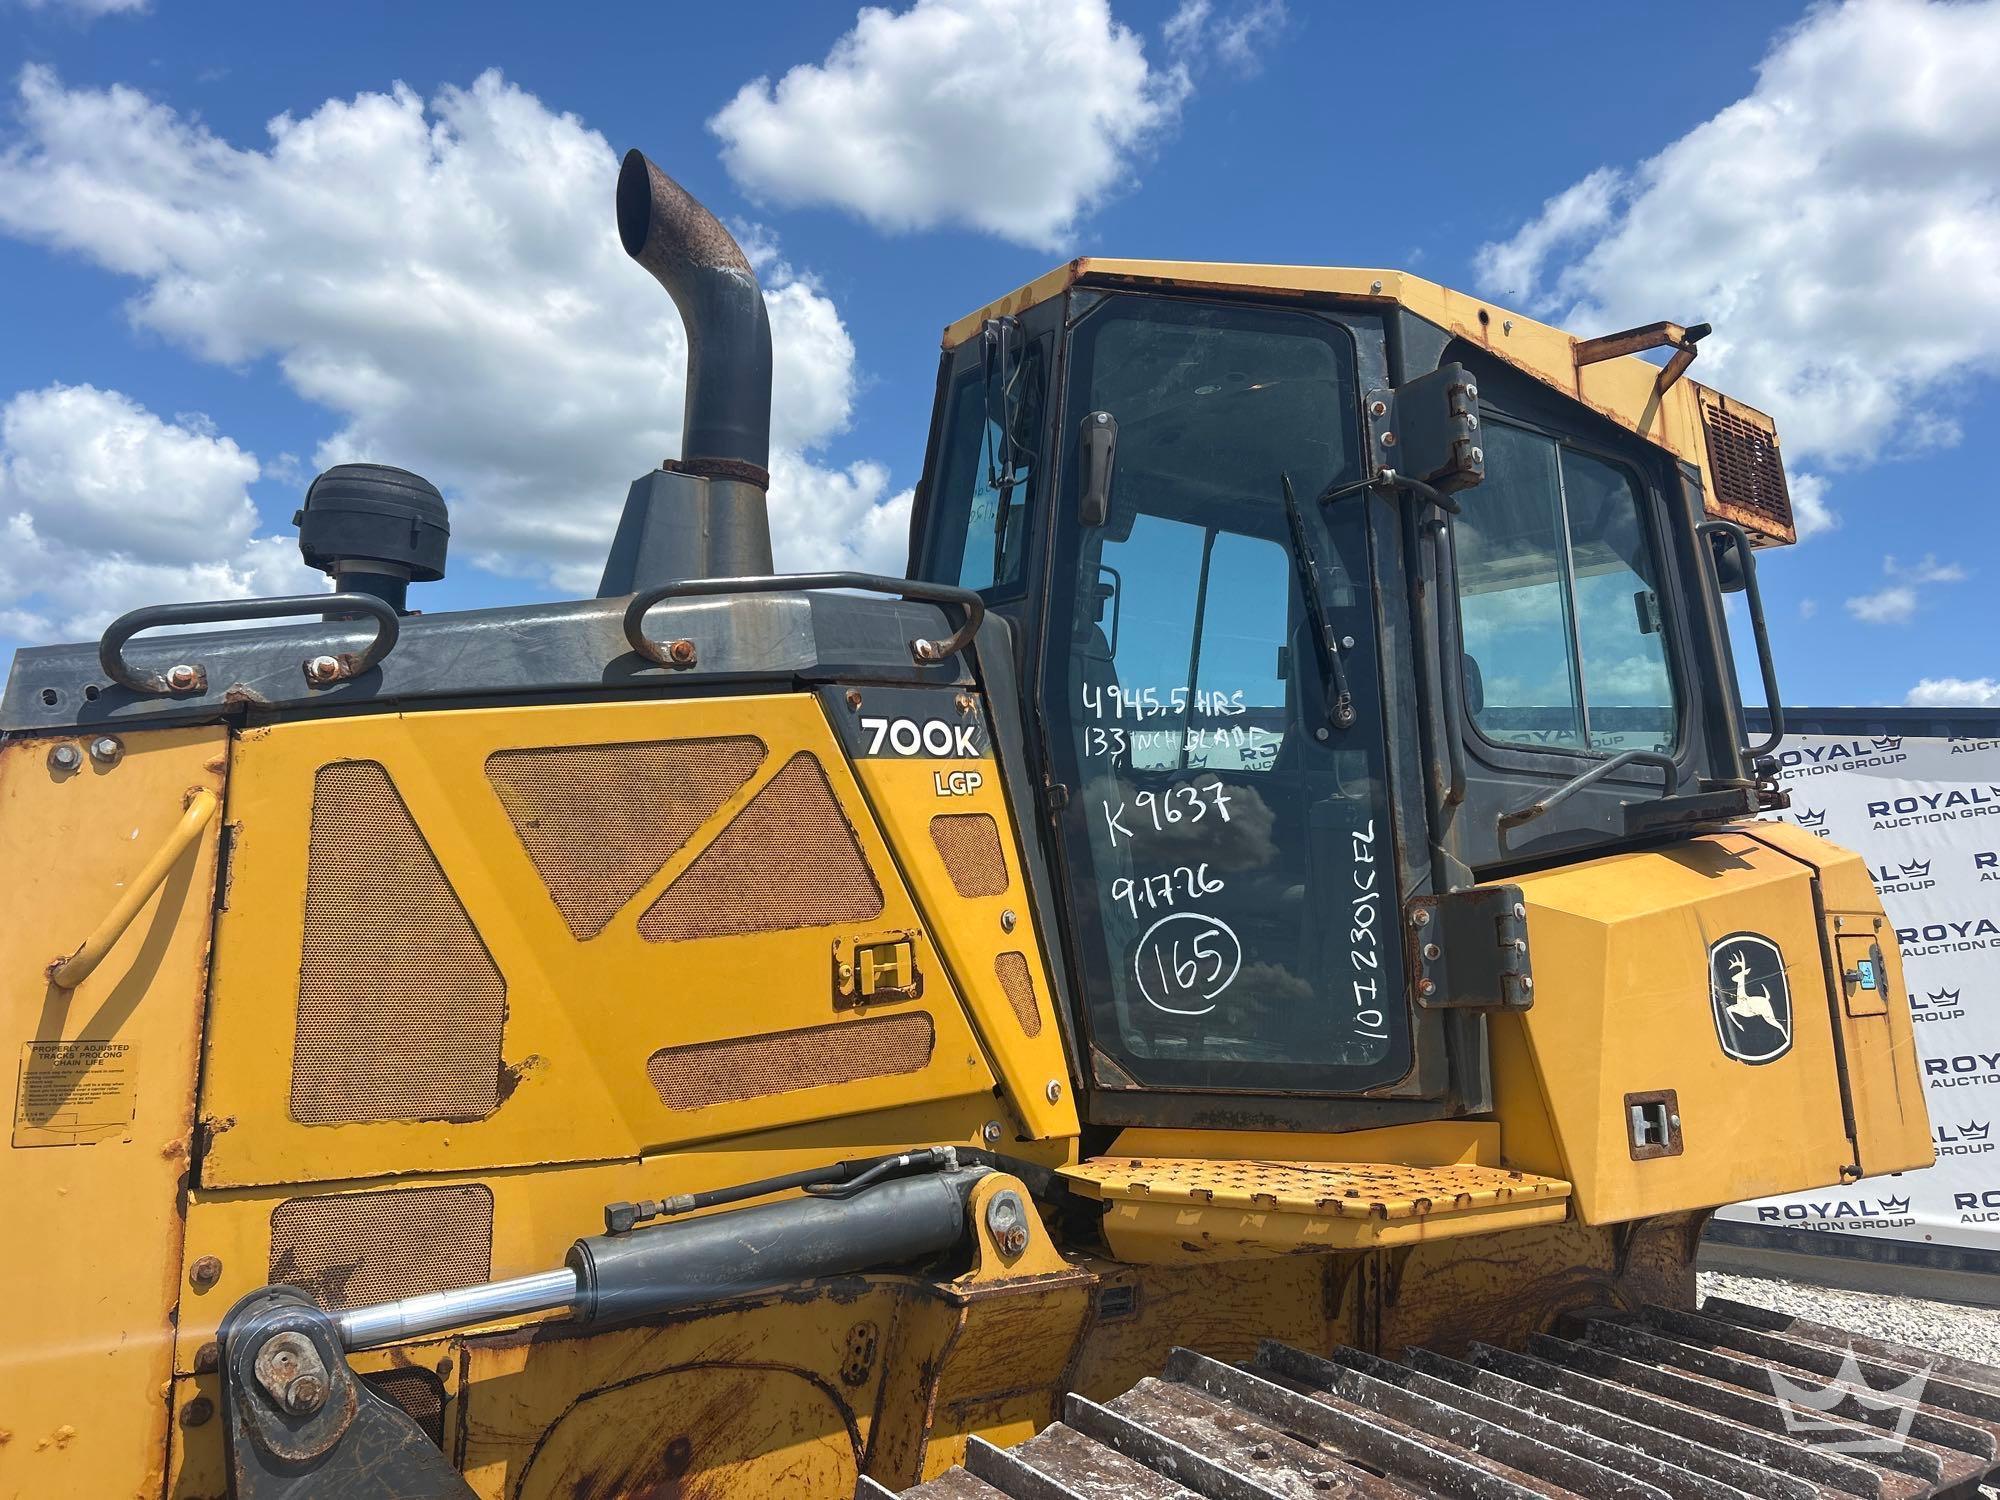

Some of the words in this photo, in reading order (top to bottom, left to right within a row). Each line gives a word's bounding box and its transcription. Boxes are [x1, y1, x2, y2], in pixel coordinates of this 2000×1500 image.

[1194, 689, 1246, 717] HRS
[860, 717, 980, 757] 700K
[1128, 730, 1178, 751] INCH
[1183, 724, 1271, 752] BLADE
[1772, 763, 1839, 781] UCTION
[1842, 753, 1907, 771] GROUP
[933, 770, 982, 797] LGP
[1867, 788, 1992, 818] ROYAL
[1872, 811, 1957, 831] AUCTION
[1901, 939, 1987, 958] AUCTION
[1154, 930, 1222, 995] 165
[1911, 1009, 1966, 1024] ROUP
[32, 1045, 80, 1053] PROPERLY
[83, 1044, 130, 1052] ADJUSTED
[39, 1052, 75, 1060] TRACKS
[80, 1051, 122, 1059] PROLONG
[53, 1059, 80, 1067] CHAIN
[85, 1058, 104, 1066] LIFE
[1757, 1200, 1880, 1221] ROYAL
[1849, 1218, 1916, 1230] GROUP
